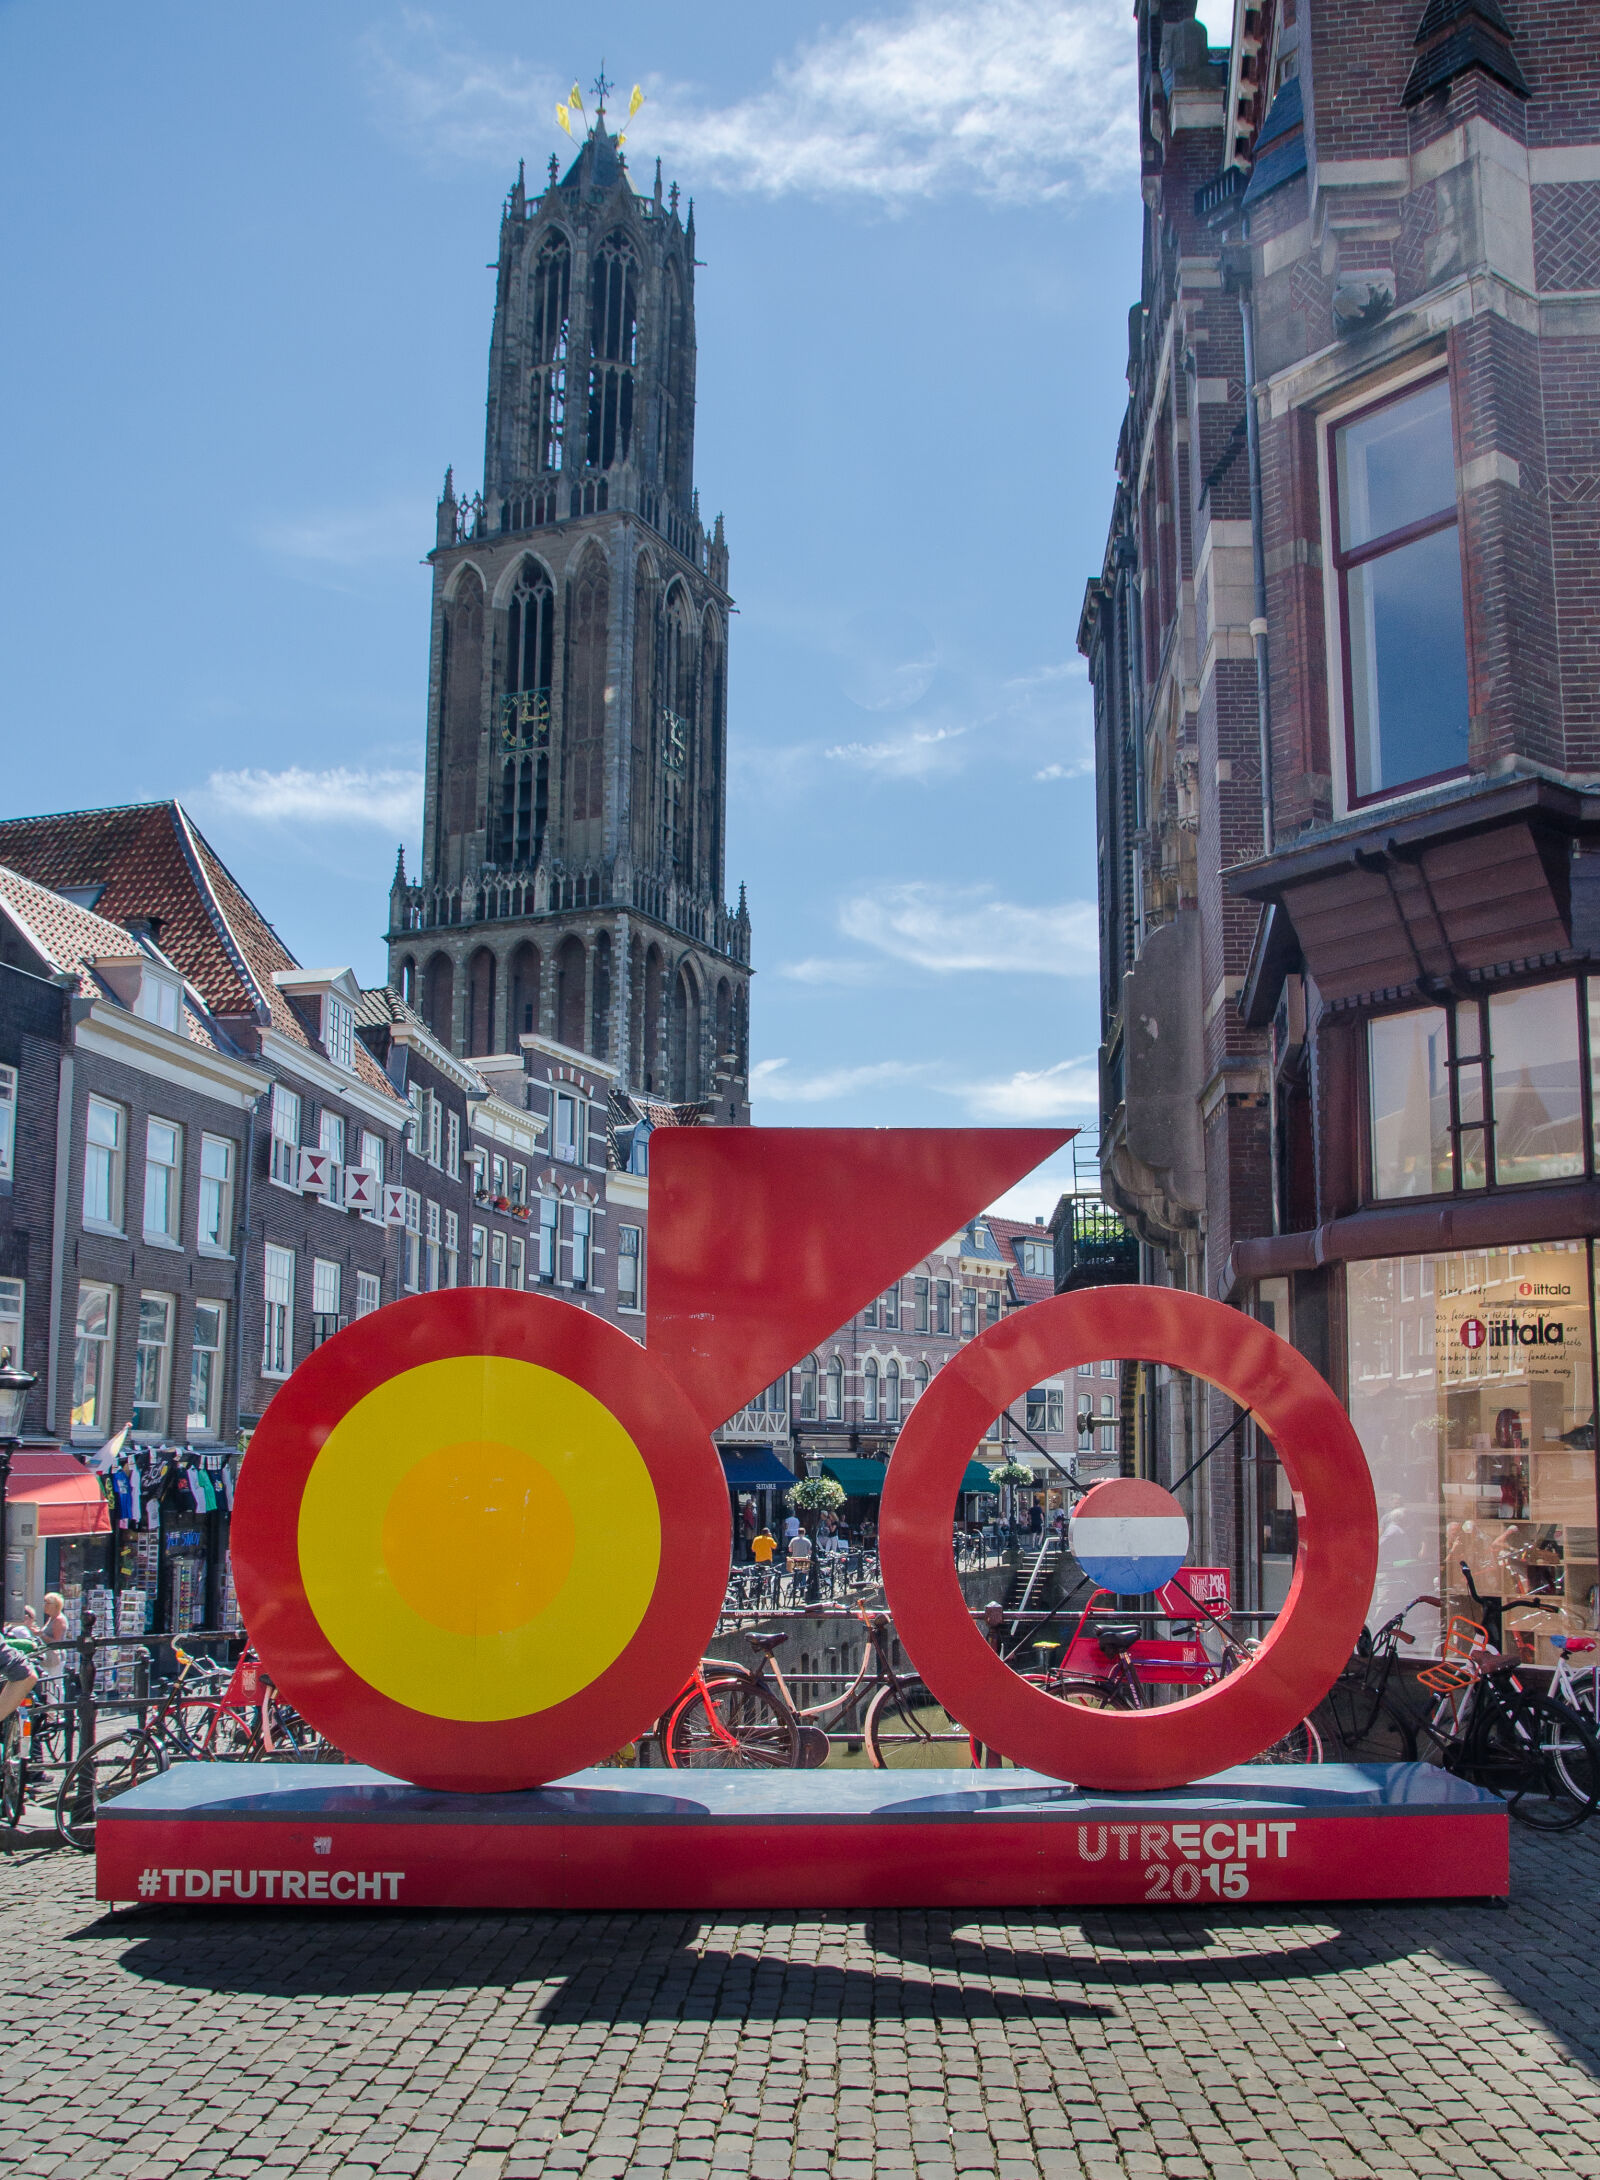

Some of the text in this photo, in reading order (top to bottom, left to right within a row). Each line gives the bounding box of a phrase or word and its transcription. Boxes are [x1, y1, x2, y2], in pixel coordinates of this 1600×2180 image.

[1533, 1284, 1571, 1295] iittala
[1488, 1316, 1564, 1347] iittala
[1078, 1823, 1297, 1861] UTRECHT
[138, 1869, 405, 1900] #TDFUTRECHT
[1145, 1863, 1250, 1900] 2015
